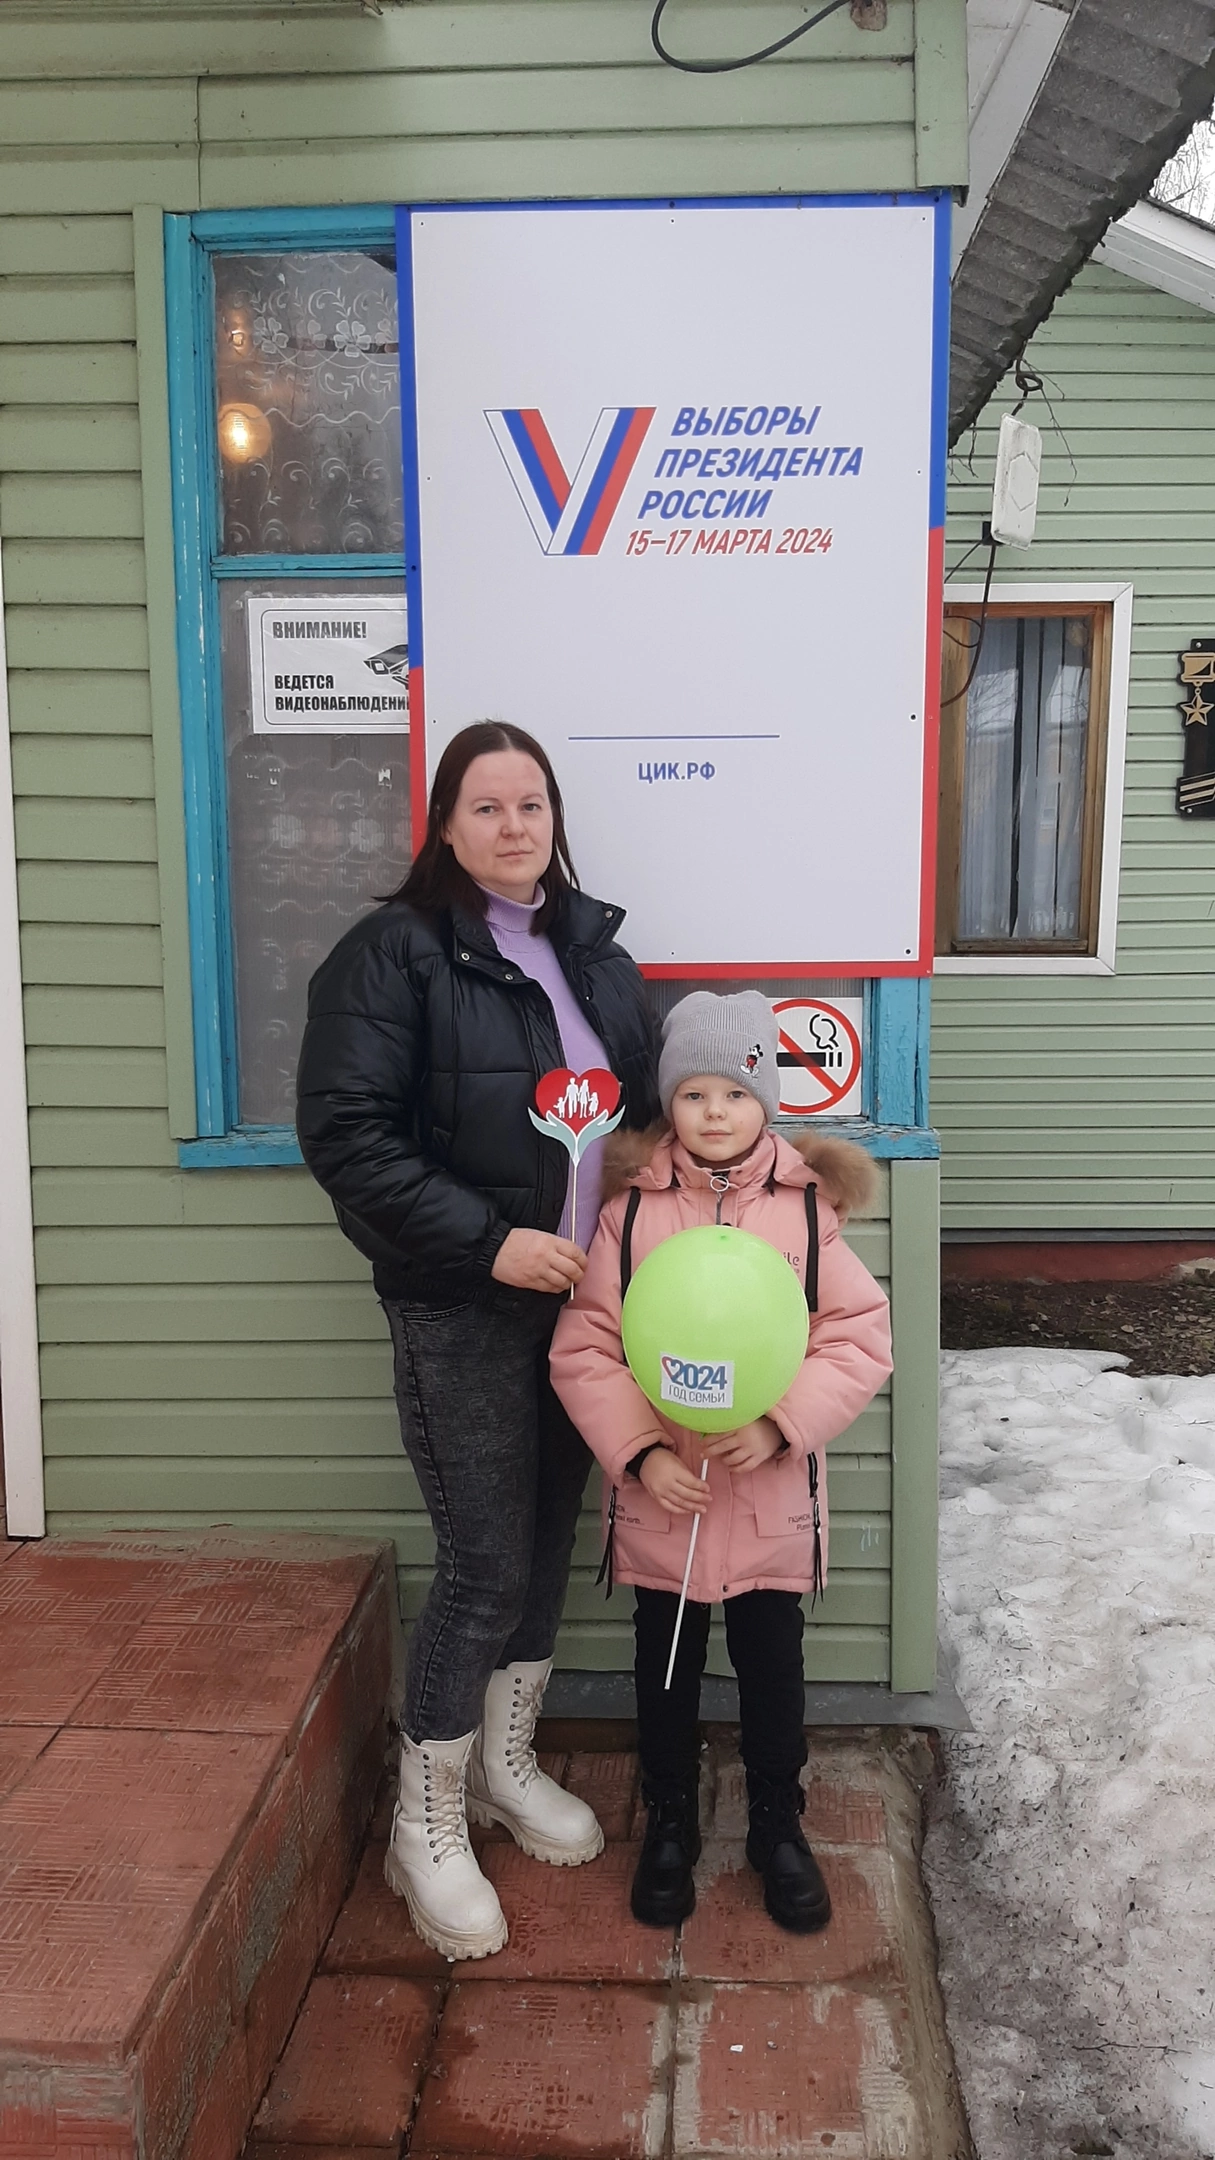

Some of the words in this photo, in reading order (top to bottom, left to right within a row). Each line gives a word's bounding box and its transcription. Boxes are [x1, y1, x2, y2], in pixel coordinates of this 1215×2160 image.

[670, 406, 822, 437] ВЫБОРЫ
[653, 446, 864, 481] ПРЕЗИДЕНТА
[637, 489, 774, 520] РОССИИ
[691, 528, 773, 555] МАРТА
[774, 527, 834, 554] 2024
[272, 621, 367, 639] ВНИМАНИЕ!
[274, 675, 335, 691] ВЕДЕТСЯ
[275, 696, 409, 713] ВИДЕОНАБЛЮДЕНИ
[638, 761, 716, 784] ЦИК.РФ
[670, 1359, 728, 1390] 2024
